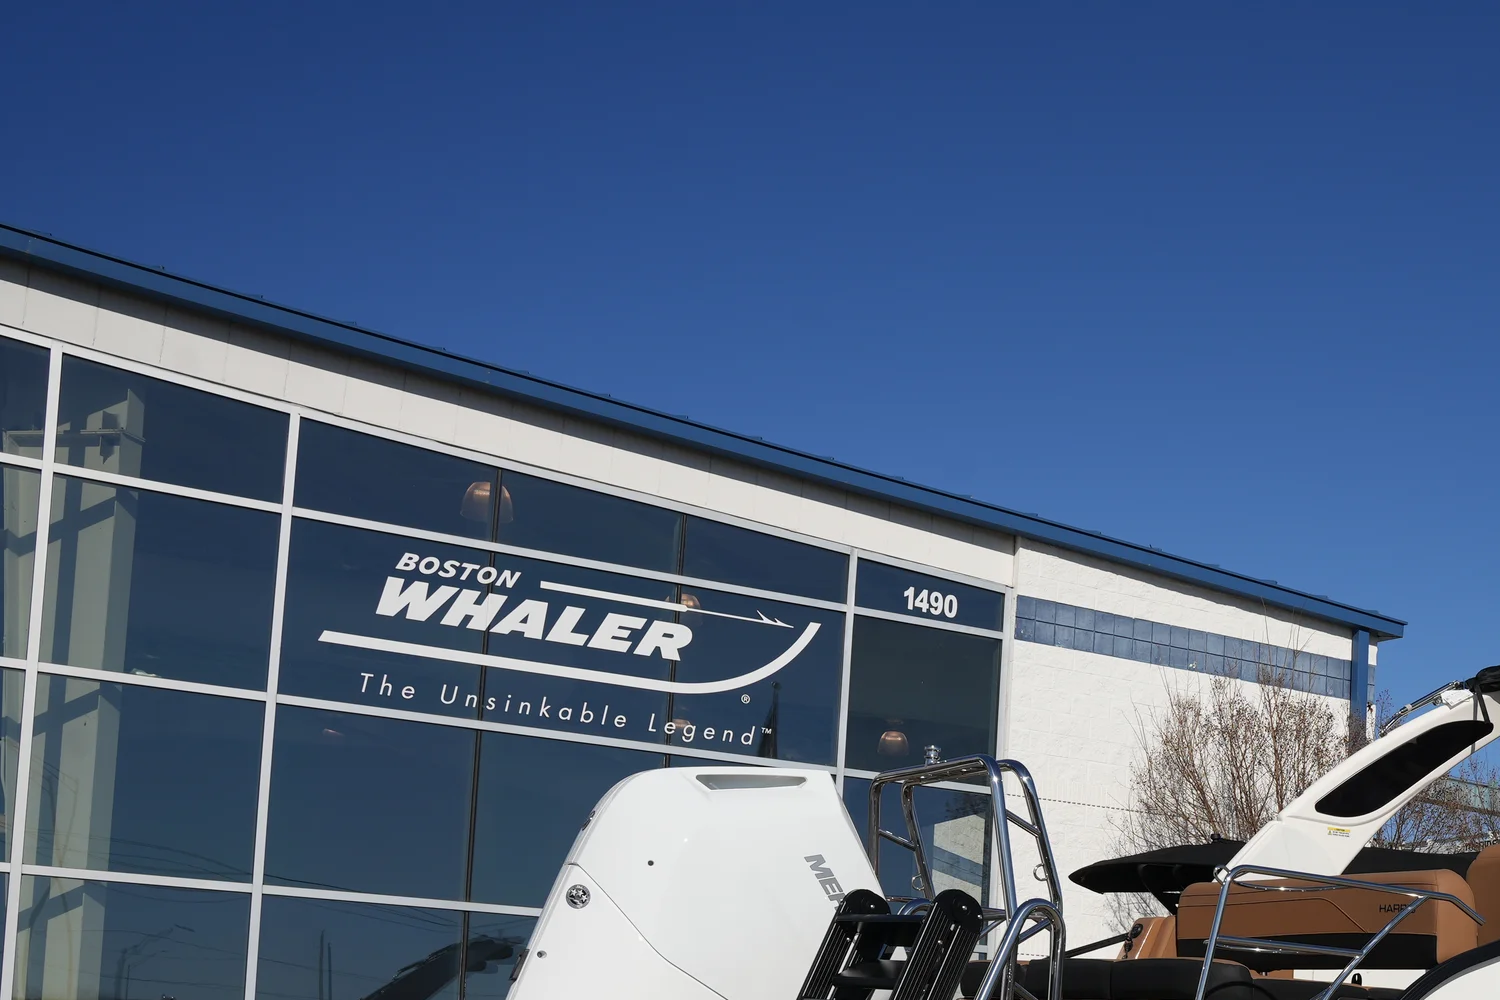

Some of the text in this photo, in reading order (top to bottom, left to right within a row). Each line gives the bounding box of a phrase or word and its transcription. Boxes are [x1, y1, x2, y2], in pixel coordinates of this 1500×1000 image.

[395, 552, 522, 589] BOSTON
[375, 576, 693, 662] WHALER
[902, 586, 958, 619] 1490
[360, 672, 415, 699] The
[440, 684, 628, 729] Unsinkable
